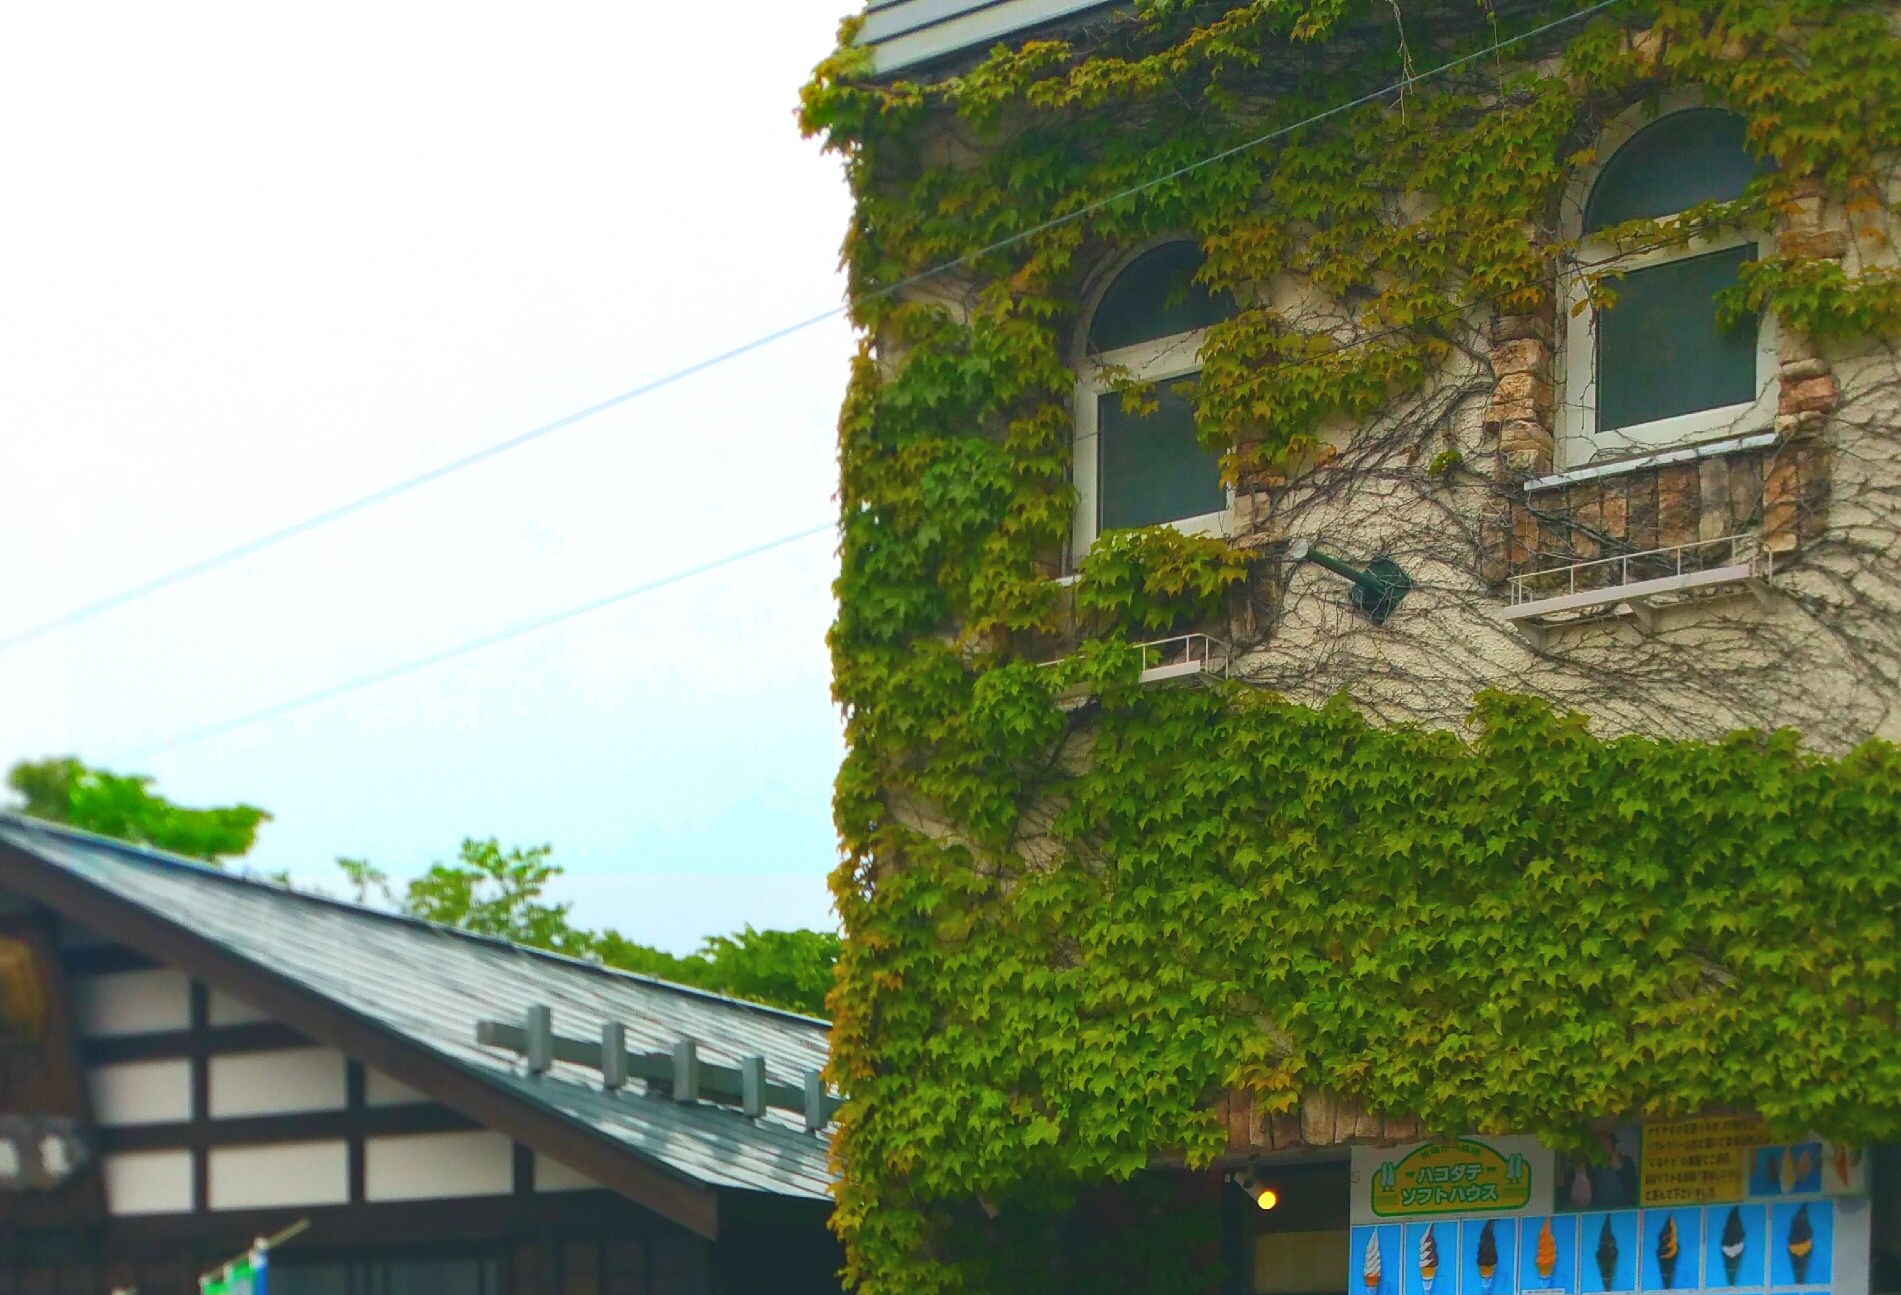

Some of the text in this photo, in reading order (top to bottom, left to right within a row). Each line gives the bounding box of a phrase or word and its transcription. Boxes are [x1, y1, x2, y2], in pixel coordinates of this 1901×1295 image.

[1416, 1163, 1484, 1184] ハコダテ
[1401, 1184, 1498, 1206] ソフトハウス
